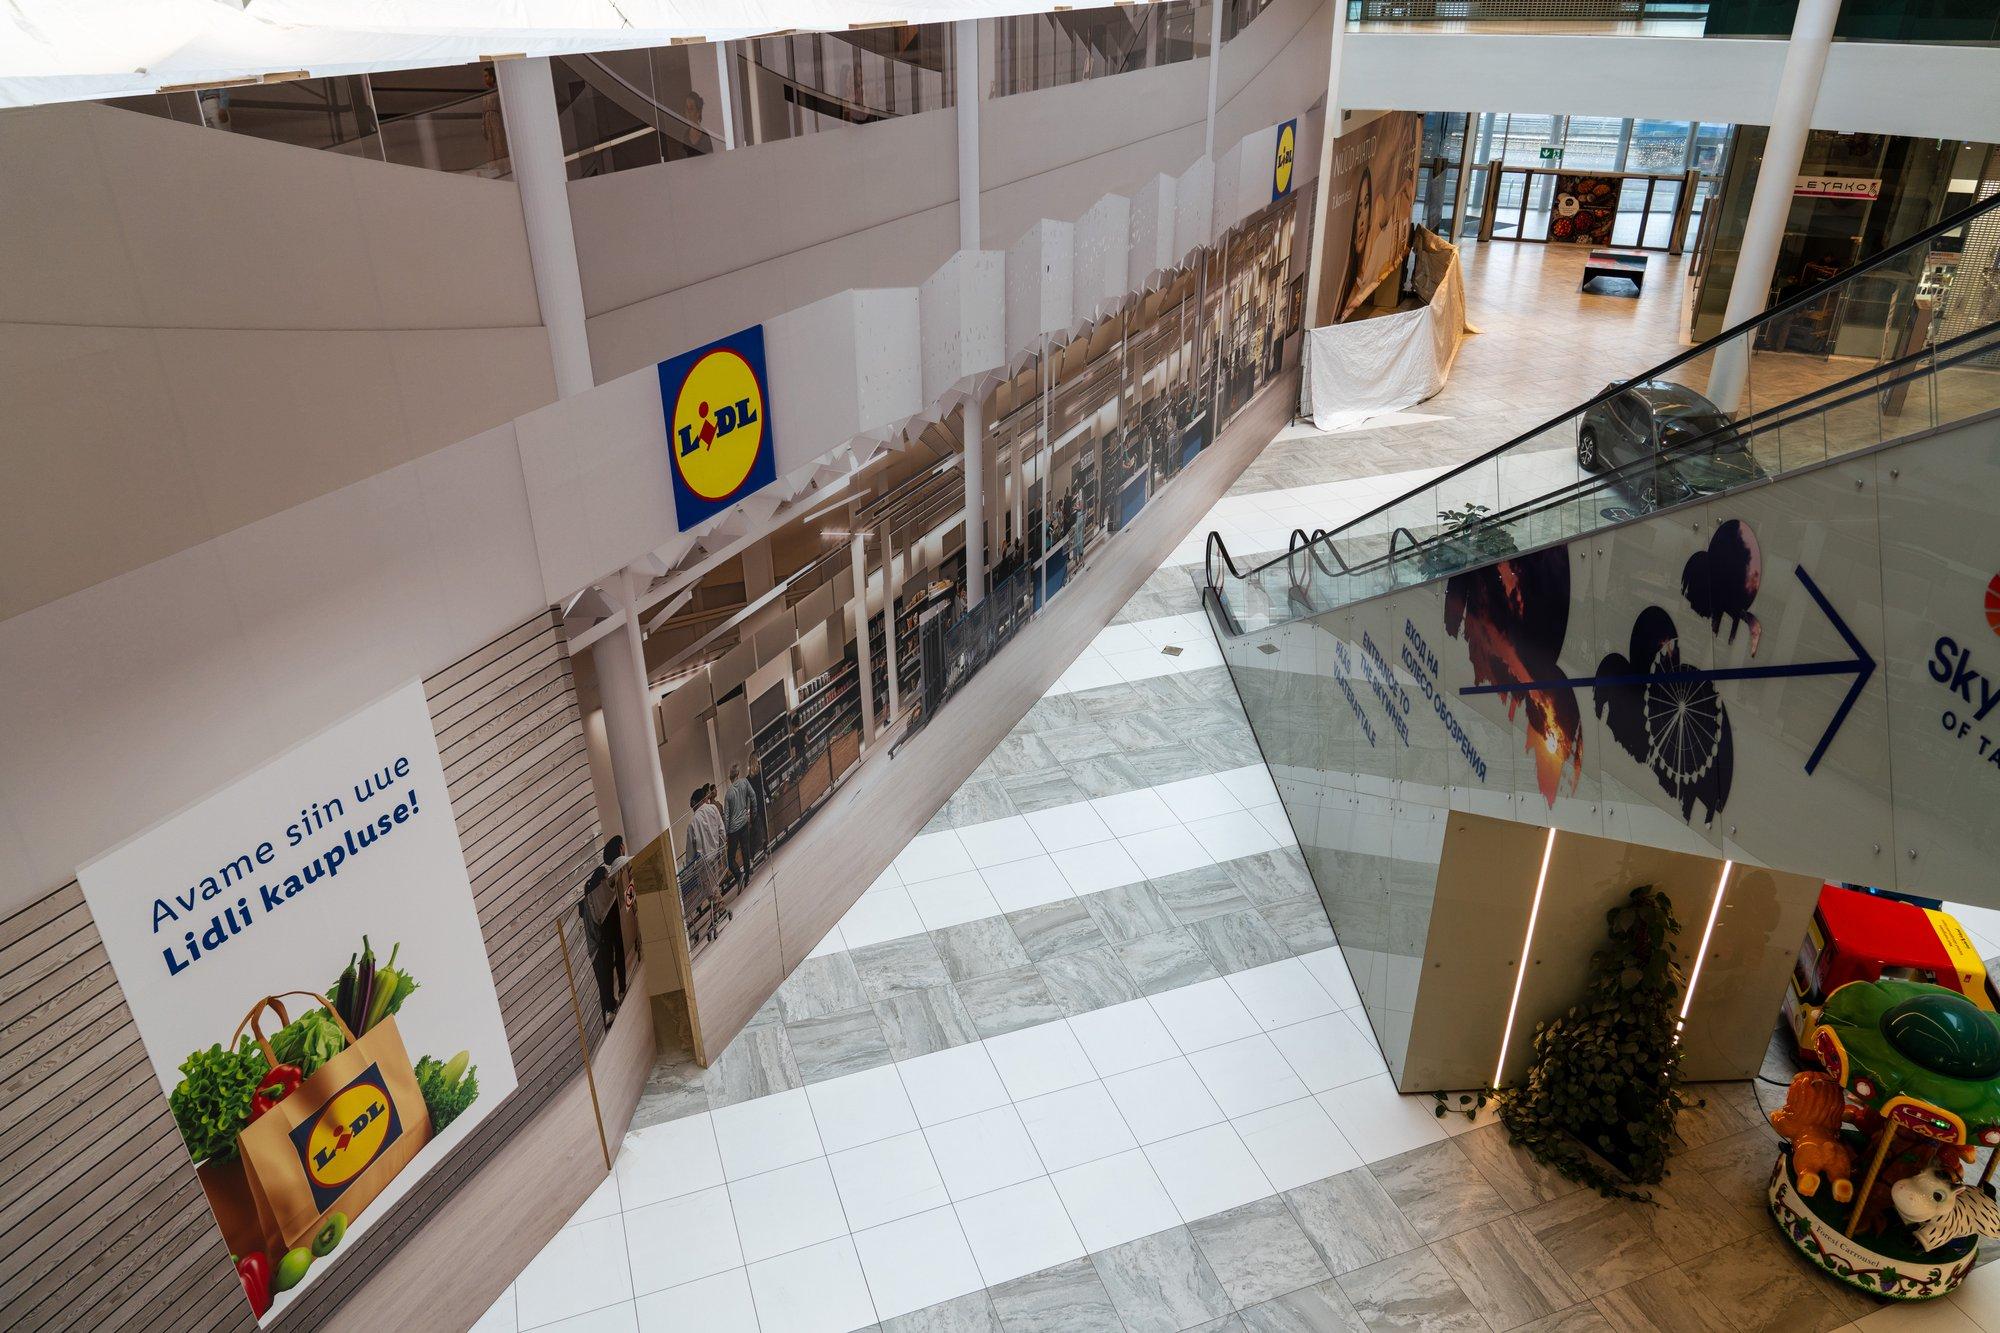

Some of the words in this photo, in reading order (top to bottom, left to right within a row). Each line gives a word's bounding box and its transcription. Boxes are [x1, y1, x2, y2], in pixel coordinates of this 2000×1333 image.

[1362, 631, 1399, 698] ENTRANCE
[1399, 687, 1410, 715] TO
[1404, 618, 1427, 663] ВХОД
[1426, 651, 1439, 679] НА
[1333, 660, 1377, 748] VAATERATTALE
[1360, 652, 1372, 685] THE
[1372, 681, 1410, 748] SKYWHEEL
[1401, 643, 1433, 700] КОЛЕСО
[1433, 694, 1487, 783] ОБОЗРЕНИЯ
[1941, 710, 1972, 739] OF
[152, 840, 275, 933] Avame
[285, 798, 344, 846] siin
[353, 756, 410, 803] uue
[162, 897, 253, 976] Lidli
[259, 789, 419, 913] kaupluse!
[1816, 1224, 1839, 1246] Forest
[1840, 1243, 1880, 1268] Carrousel
